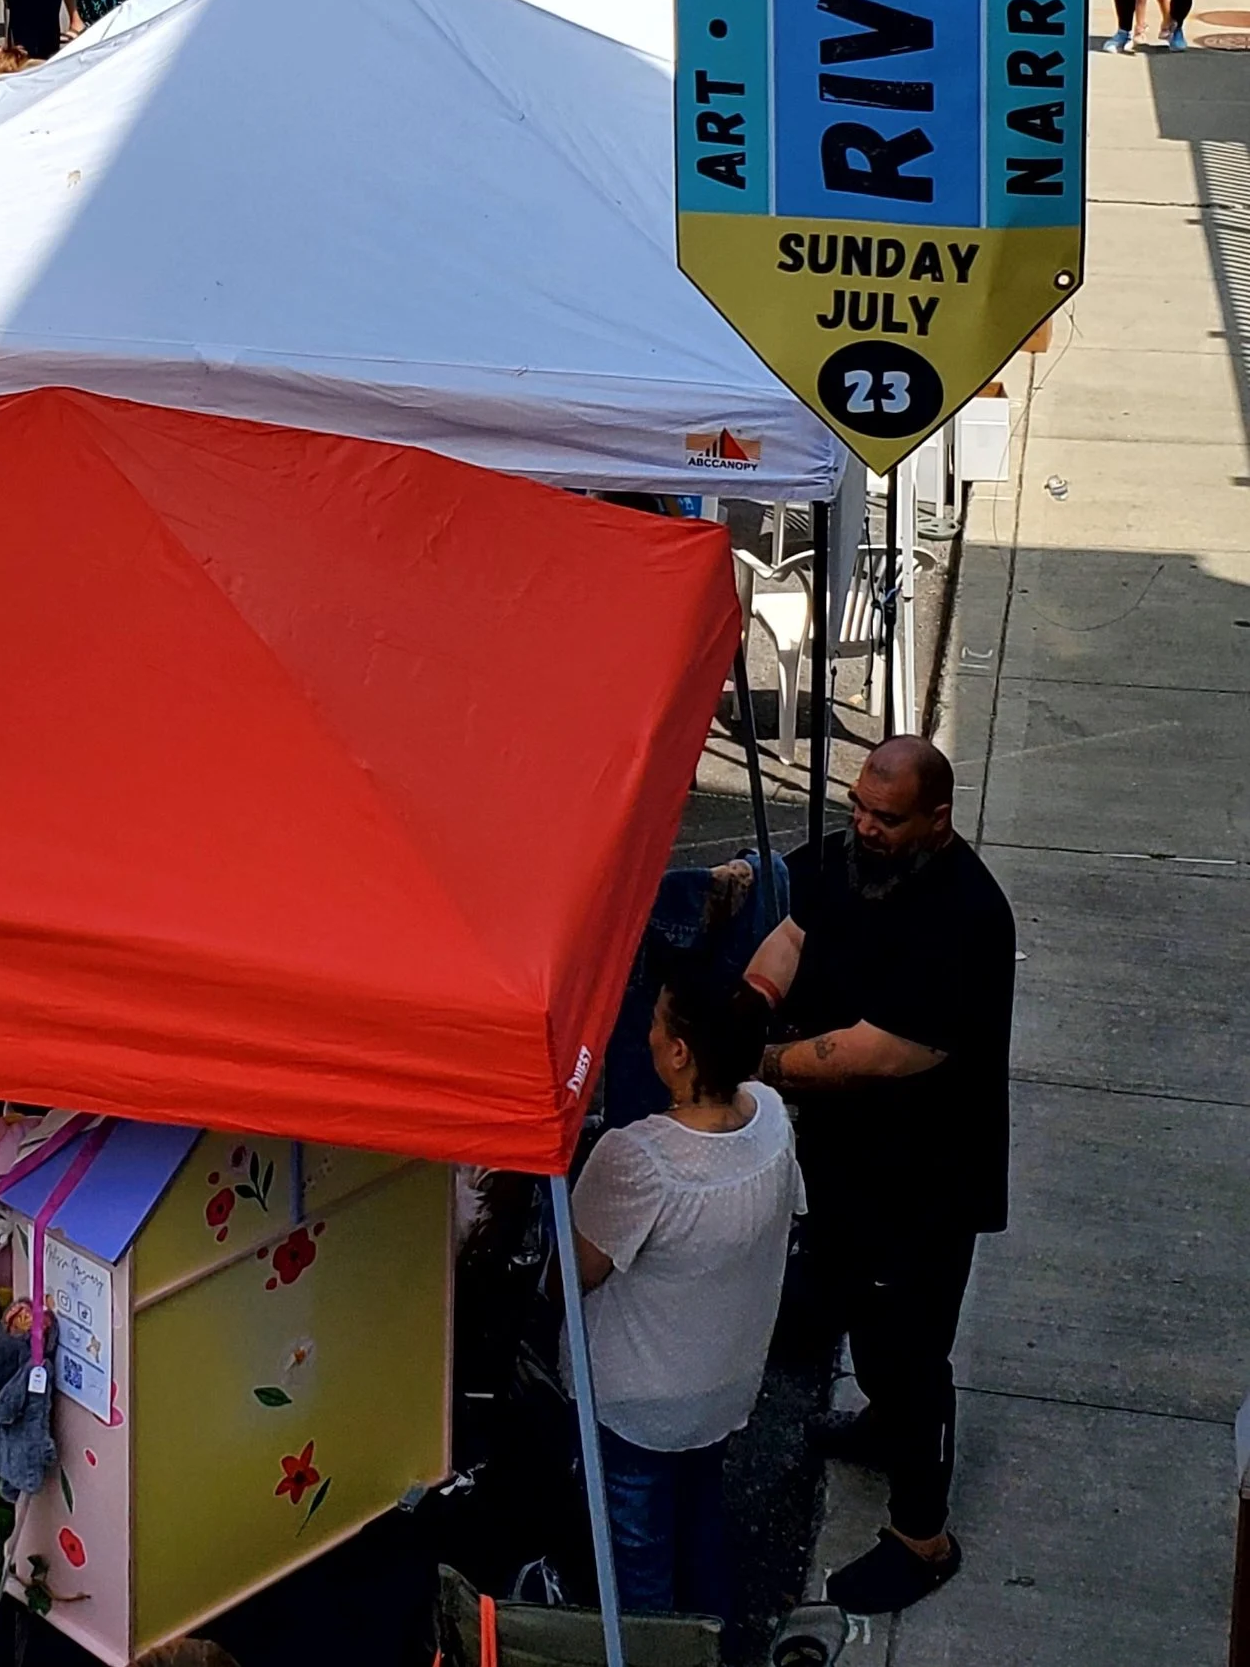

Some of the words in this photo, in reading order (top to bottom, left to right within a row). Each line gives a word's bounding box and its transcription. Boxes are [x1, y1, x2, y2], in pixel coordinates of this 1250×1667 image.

[695, 69, 746, 190] ART
[777, 233, 980, 283] SUNDAY
[816, 289, 940, 336] JULY
[844, 369, 911, 413] 23
[688, 456, 759, 472] ABCCANOPY
